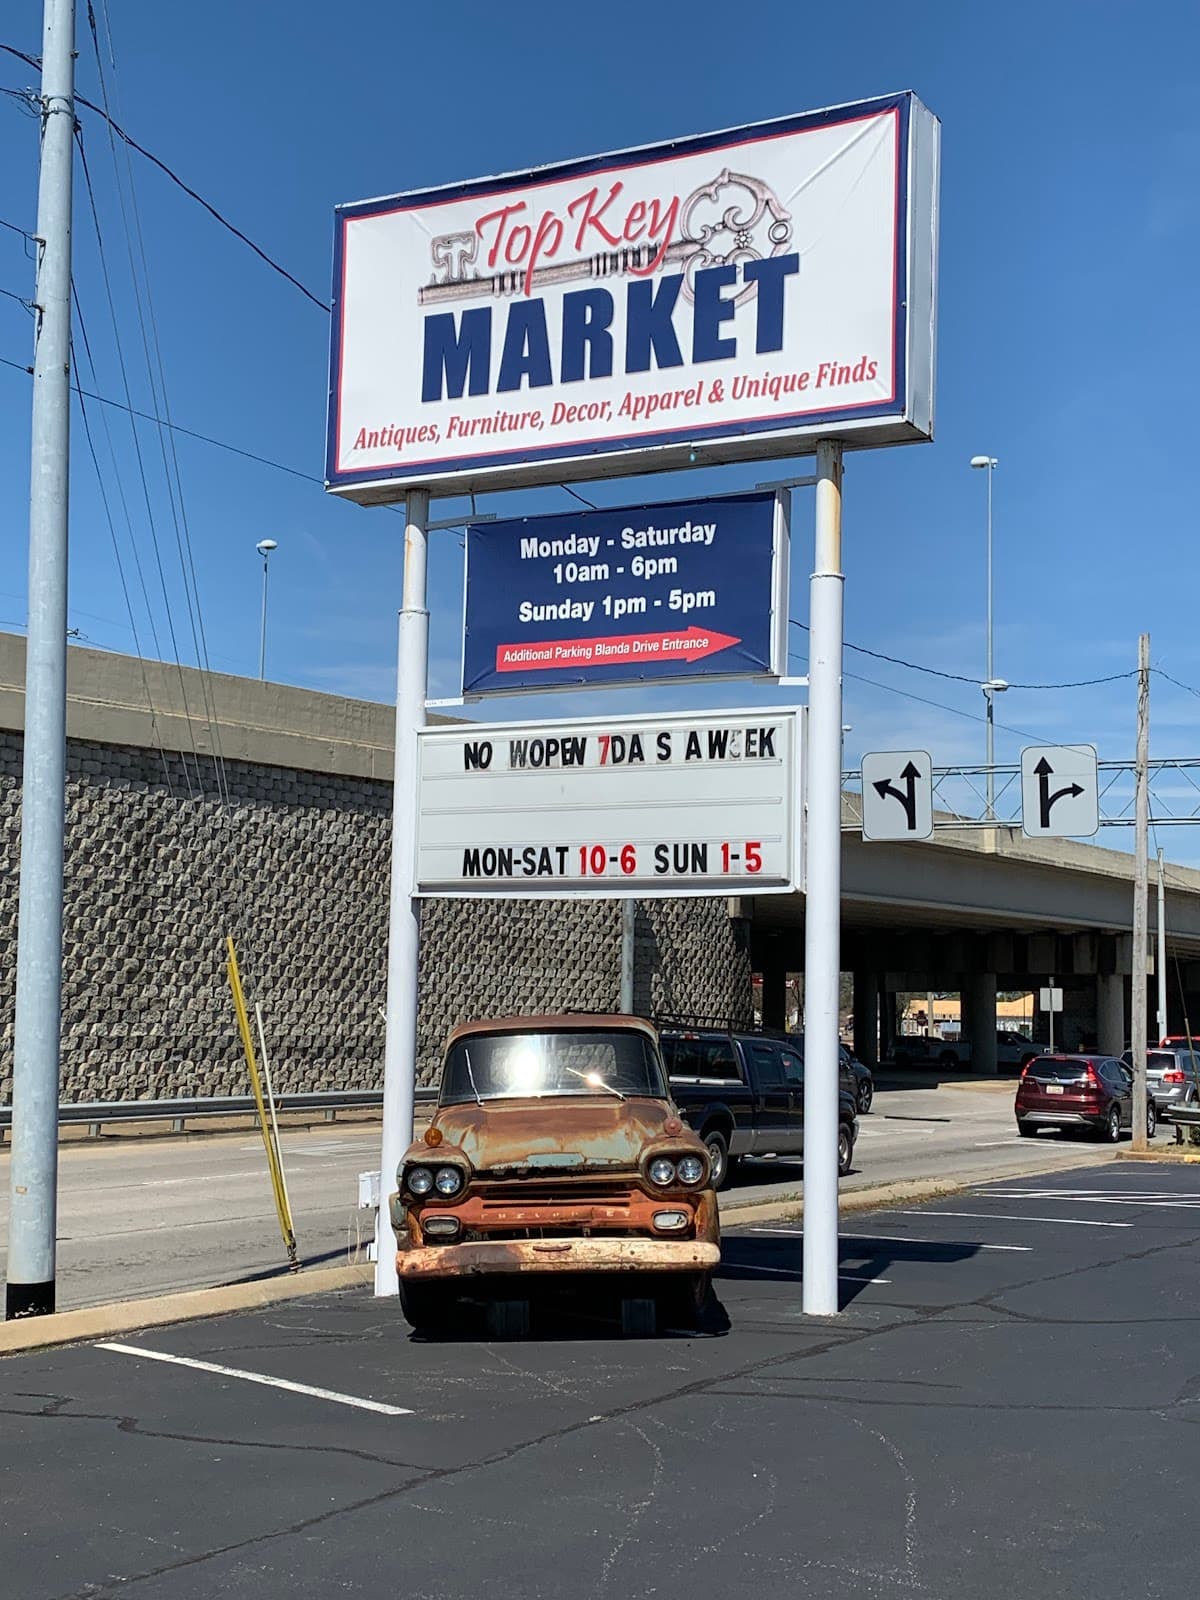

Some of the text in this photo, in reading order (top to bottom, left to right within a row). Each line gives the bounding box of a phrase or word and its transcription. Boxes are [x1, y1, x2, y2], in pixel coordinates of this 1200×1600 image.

[421, 252, 800, 403] MARKET
[353, 355, 879, 452] Antiques, Furniture, Decor, Apparel & Unique Finds
[520, 533, 600, 559] Monday
[621, 521, 717, 549] Saturday
[553, 562, 609, 584] 10am
[631, 555, 678, 580] 6pm
[518, 598, 595, 623] Sunday
[602, 595, 647, 619] 1pm
[668, 589, 716, 614] 5pm
[503, 636, 709, 663] Additional Parking Blanda Drive Entrance
[463, 741, 493, 771] NO
[462, 841, 762, 877] MON-SAT 10-6 SUN 1-5
